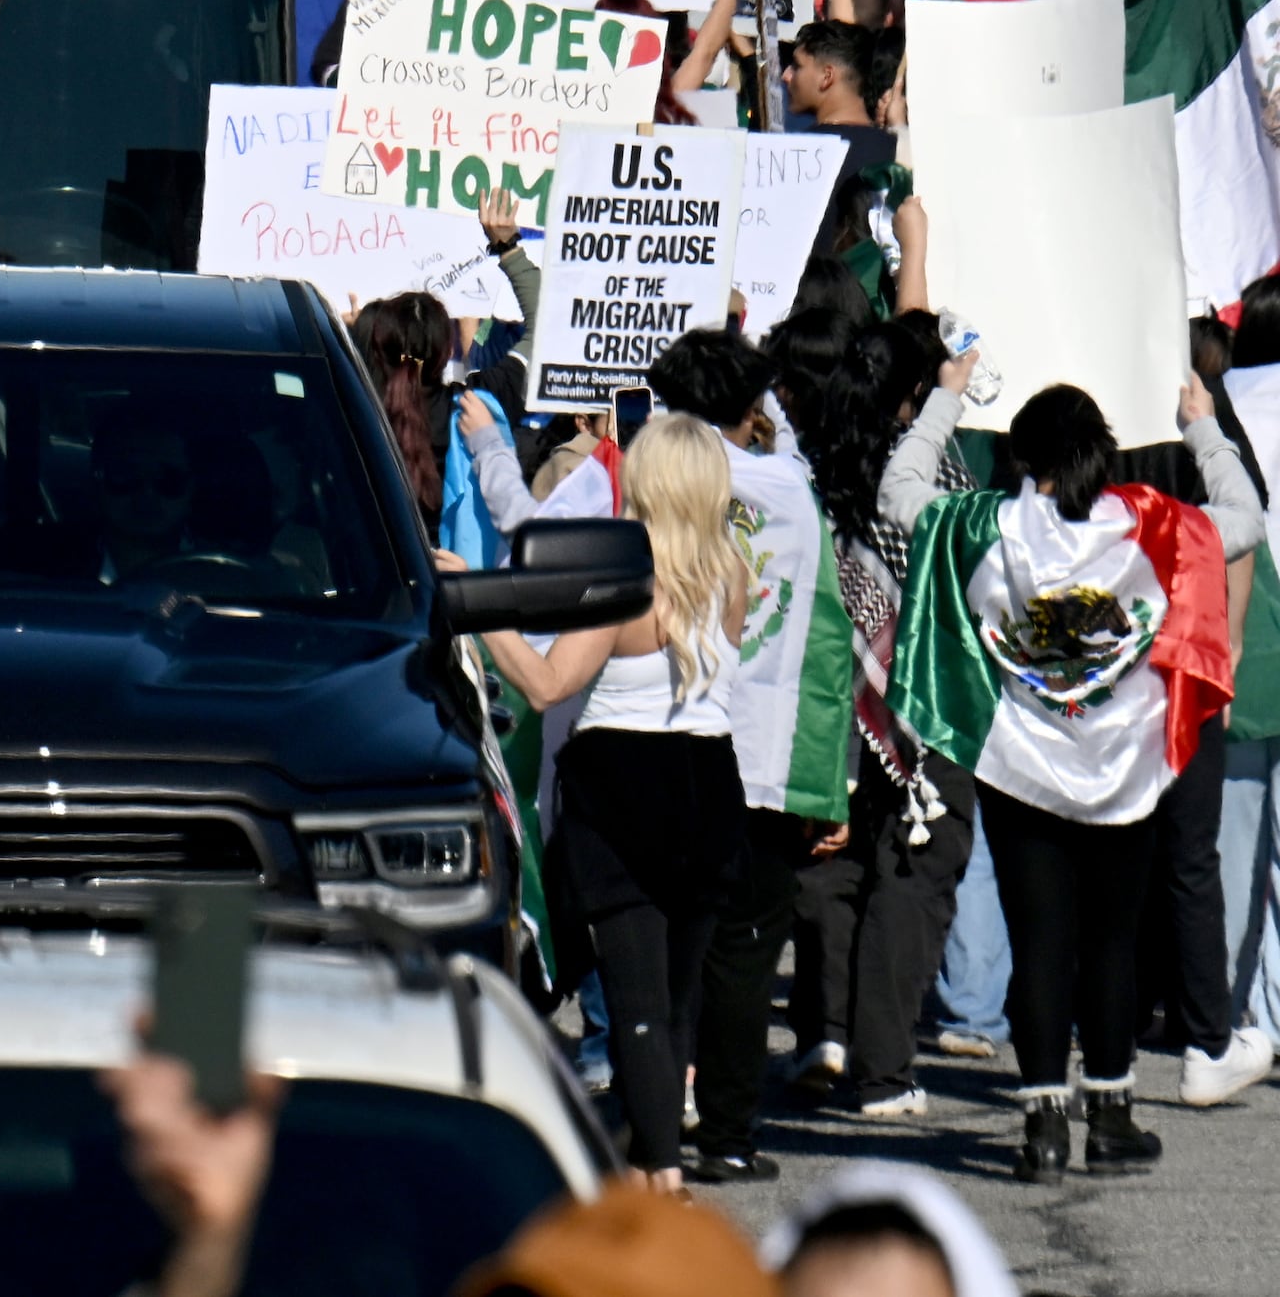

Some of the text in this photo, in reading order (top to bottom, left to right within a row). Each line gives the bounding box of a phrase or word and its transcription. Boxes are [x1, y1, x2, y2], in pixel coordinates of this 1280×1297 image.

[360, 53, 614, 113] Crosses Borders
[336, 94, 405, 140] Let
[432, 107, 460, 147] it
[611, 143, 682, 191] U.S.
[405, 148, 554, 228] HOM
[564, 195, 720, 228] IMPERIALISM
[560, 232, 716, 265] ROOT CAUSE
[604, 275, 668, 298] OF THE
[570, 297, 693, 333] MIGRANT
[545, 383, 596, 399] Liberation
[547, 369, 572, 385] Party
[575, 370, 590, 384] for
[591, 371, 639, 386] Socialism
